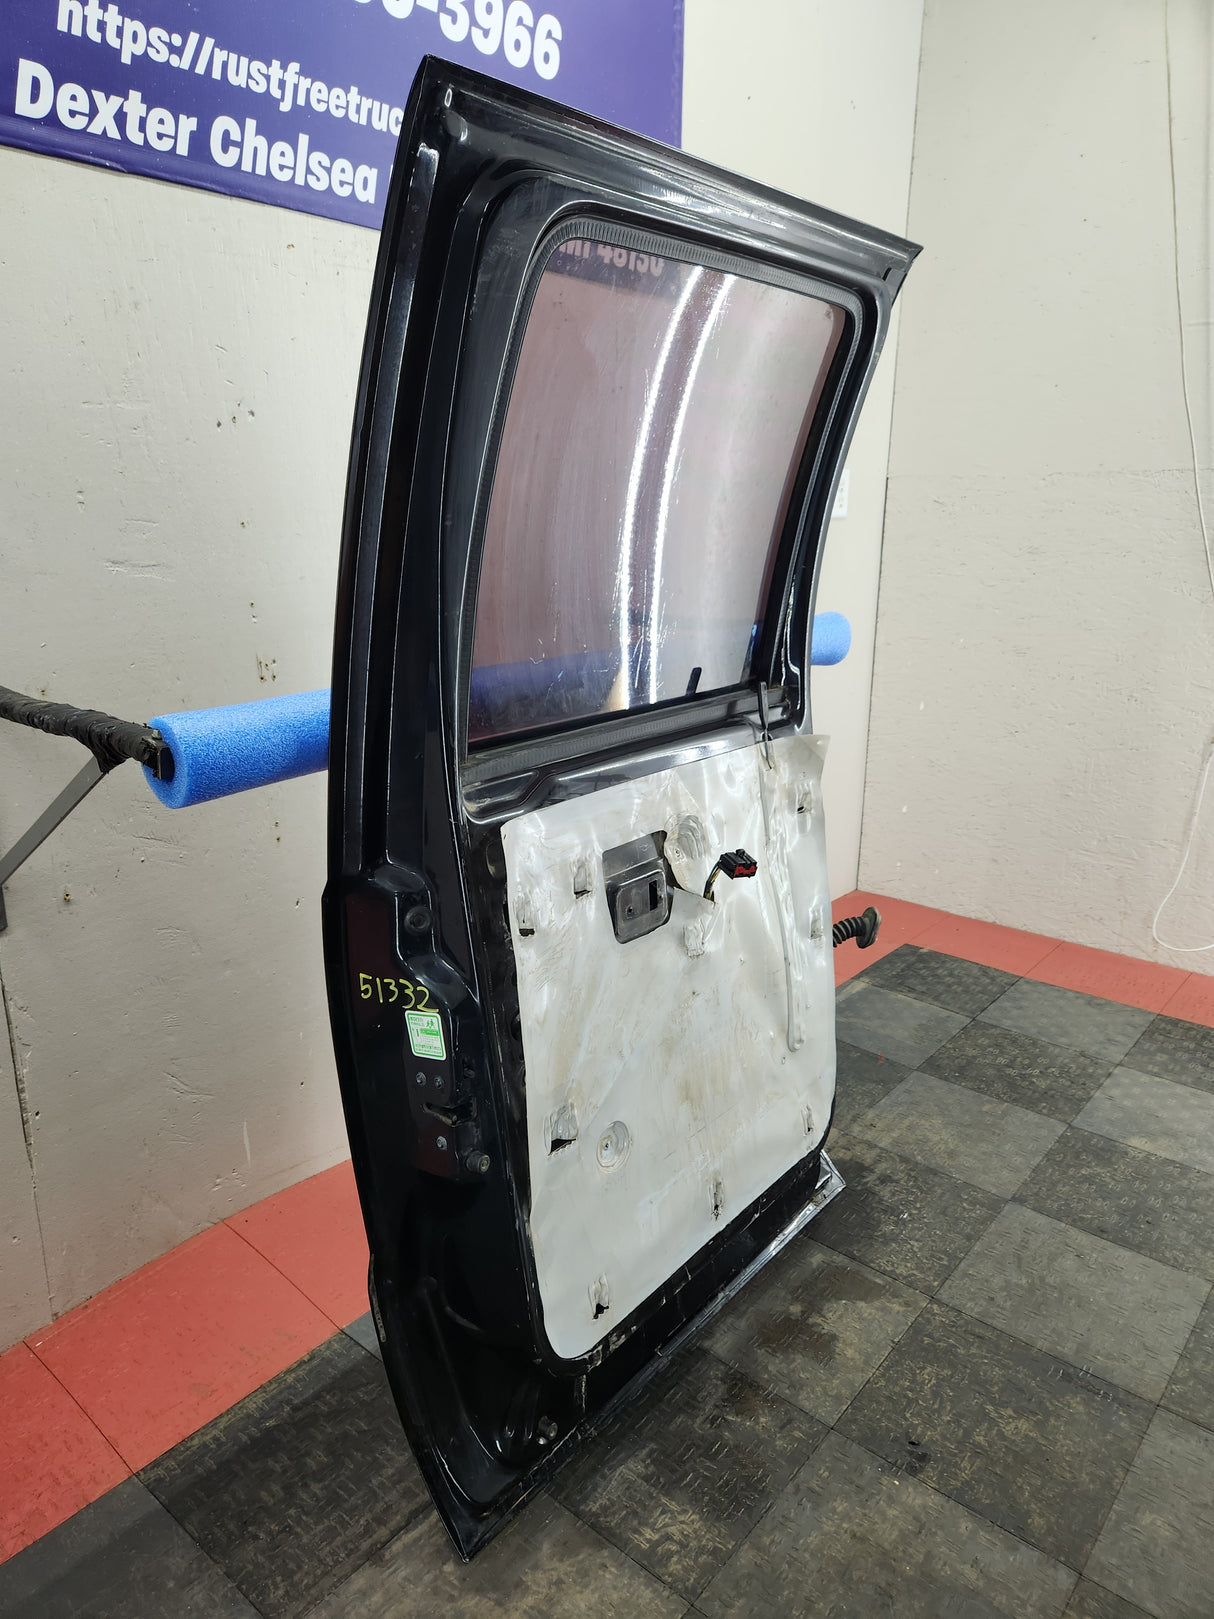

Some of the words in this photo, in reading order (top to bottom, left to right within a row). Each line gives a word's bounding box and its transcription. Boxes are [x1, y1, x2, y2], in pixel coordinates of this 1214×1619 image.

[354, 0, 563, 80] -3966
[14, 57, 198, 156] Dexter
[209, 115, 378, 204] Chelsea
[359, 972, 439, 1013] 51332
